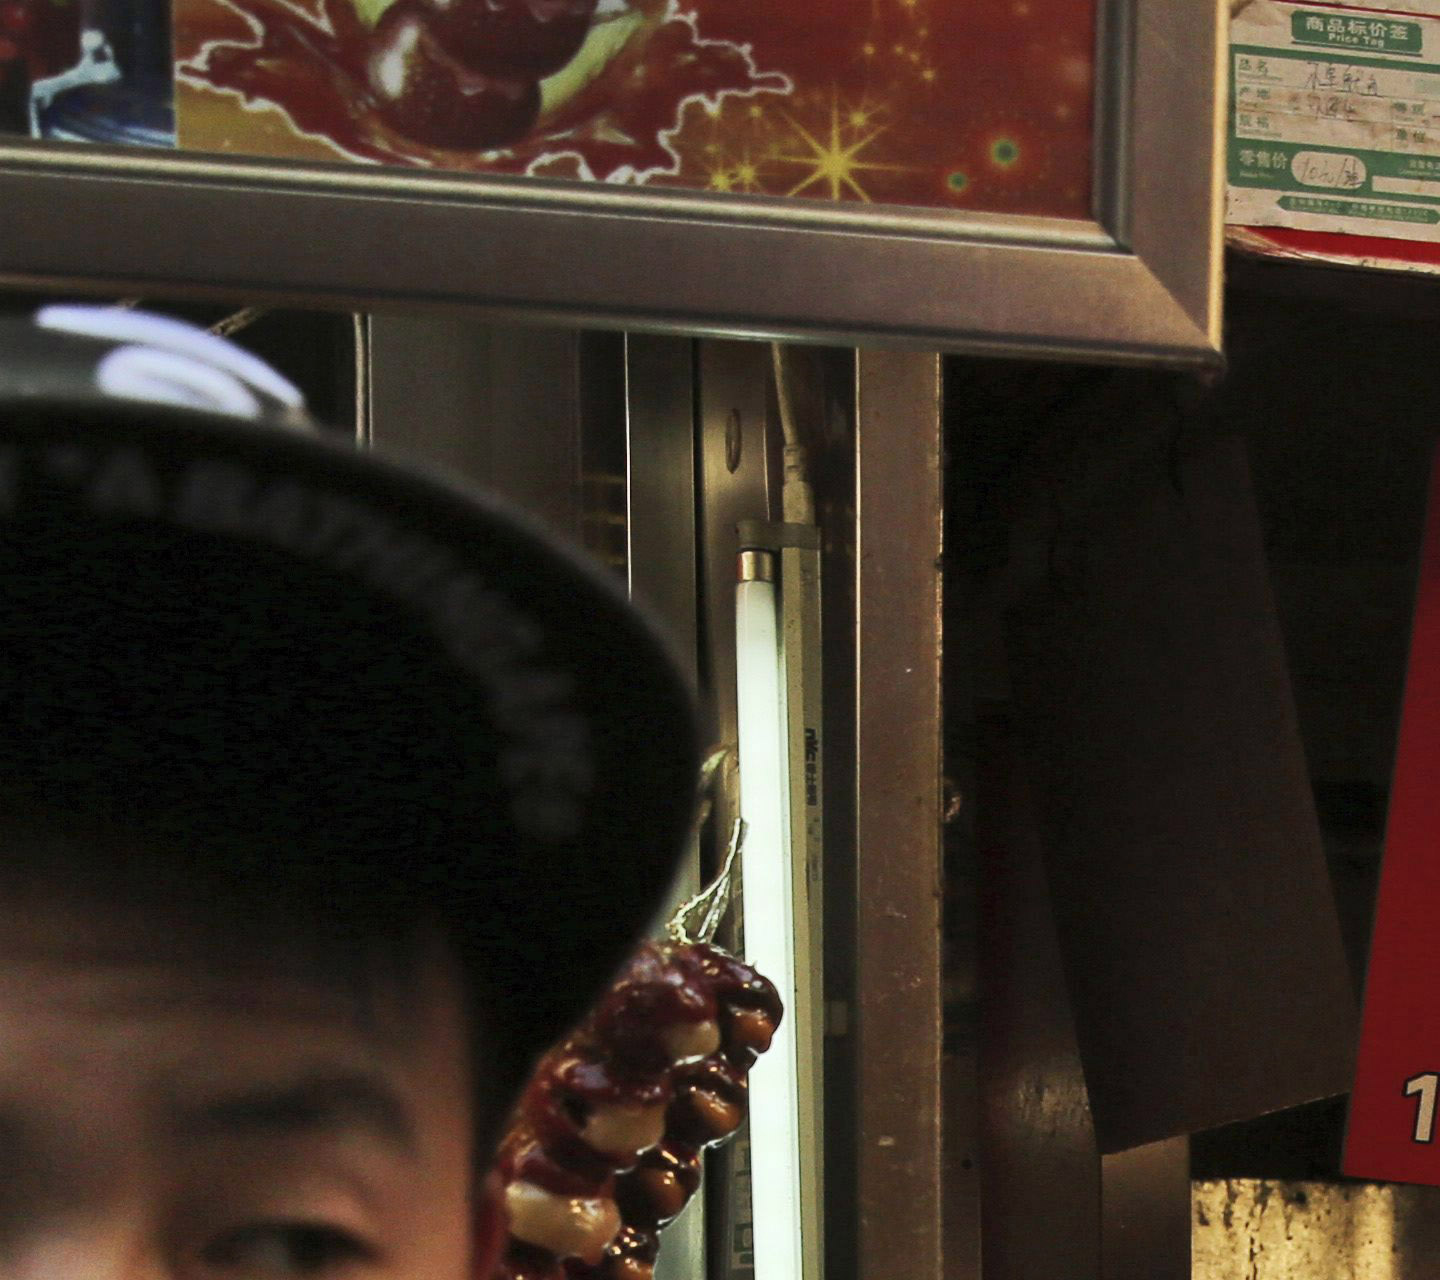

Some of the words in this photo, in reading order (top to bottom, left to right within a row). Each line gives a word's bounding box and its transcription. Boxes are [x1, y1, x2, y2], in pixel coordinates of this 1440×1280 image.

[1306, 17, 1409, 40] 商品标价签
[1328, 34, 1359, 45] Price
[1363, 36, 1385, 48] Tag
[1239, 150, 1288, 170] 零售价
